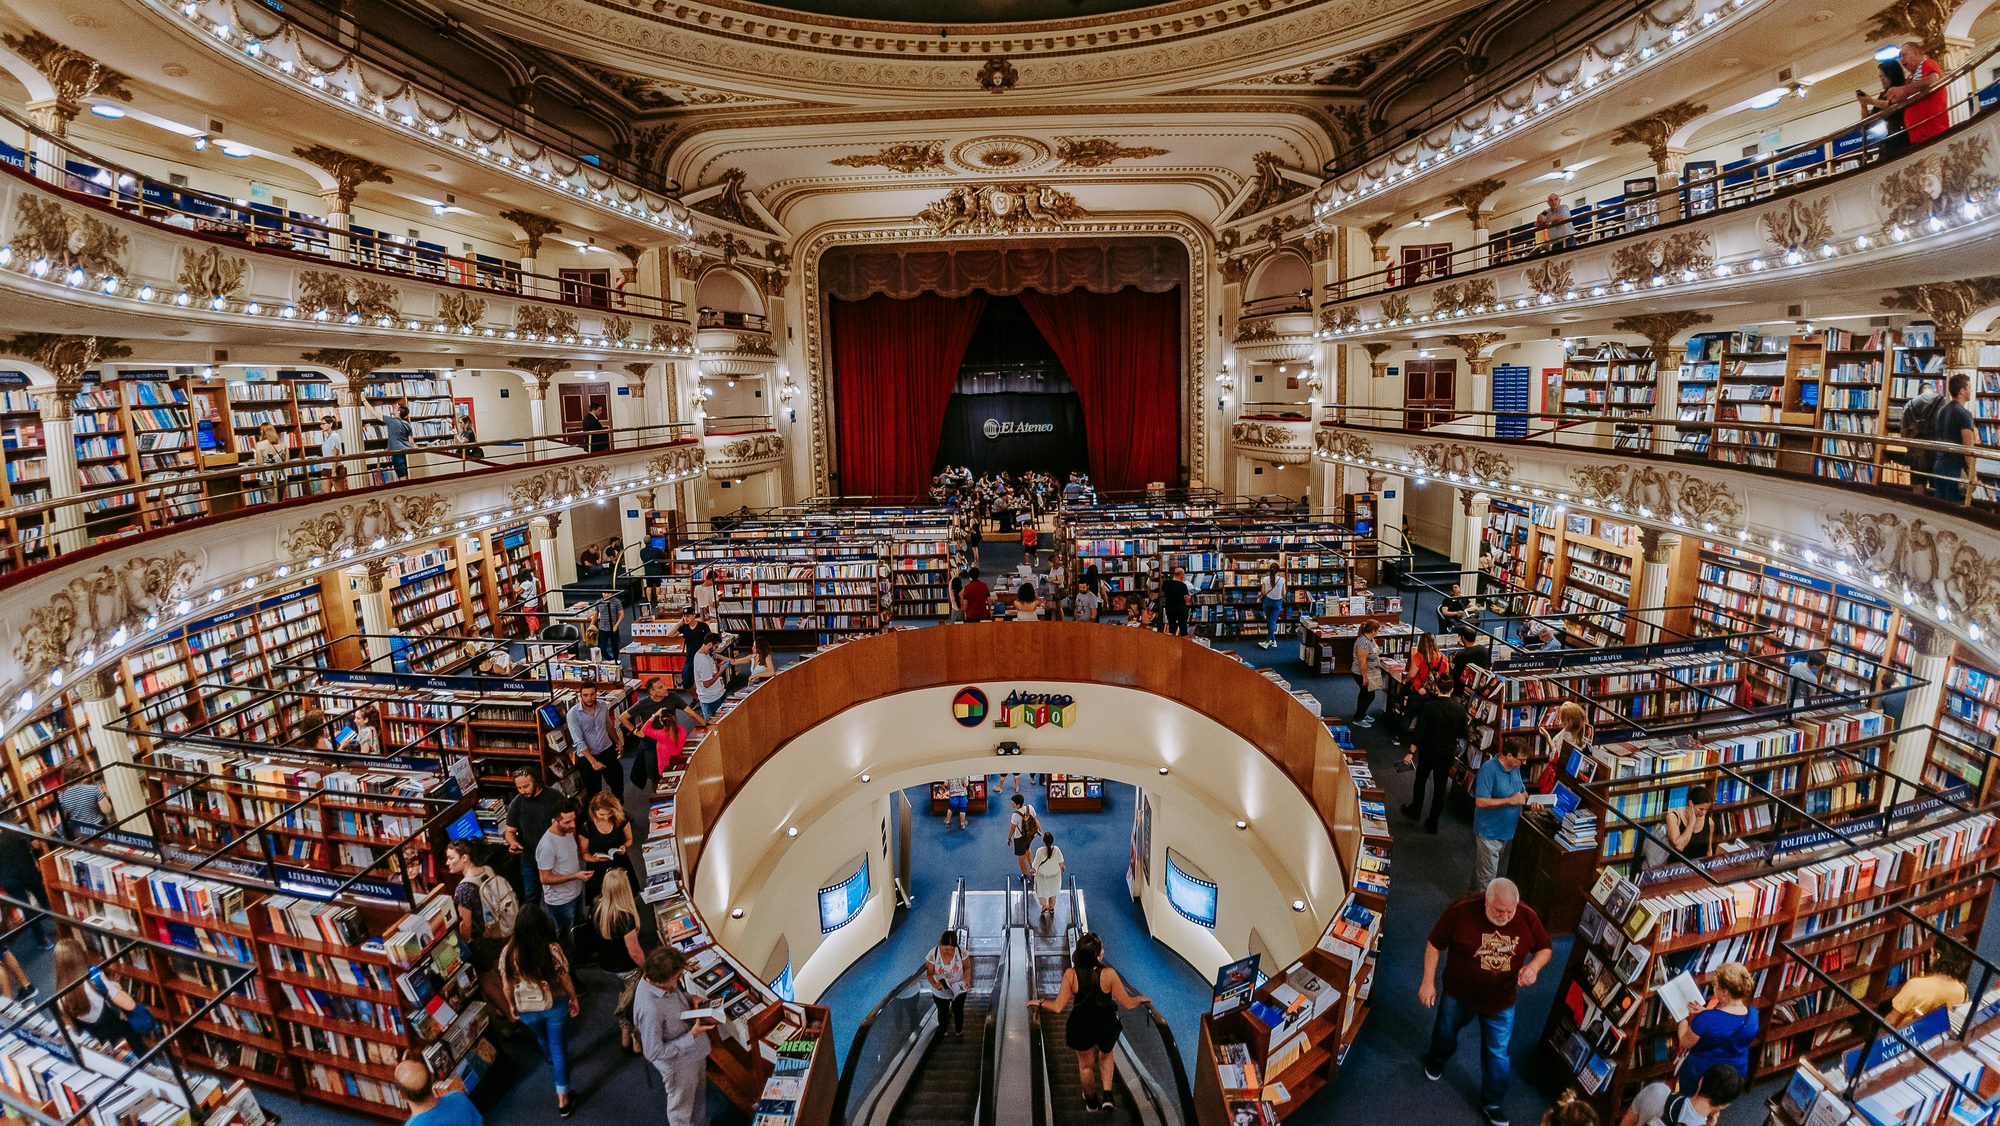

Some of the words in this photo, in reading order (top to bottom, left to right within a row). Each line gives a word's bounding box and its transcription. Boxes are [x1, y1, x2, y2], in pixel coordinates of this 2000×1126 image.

[1000, 421, 1014, 434] El
[1015, 421, 1054, 433] Ateneo
[1779, 571, 1813, 585] DICCIONARIOS
[1004, 689, 1073, 704] Ateneo
[1002, 704, 1074, 725] Junior
[1780, 835, 1817, 849] POLITICA
[288, 871, 340, 887] LITERATURA
